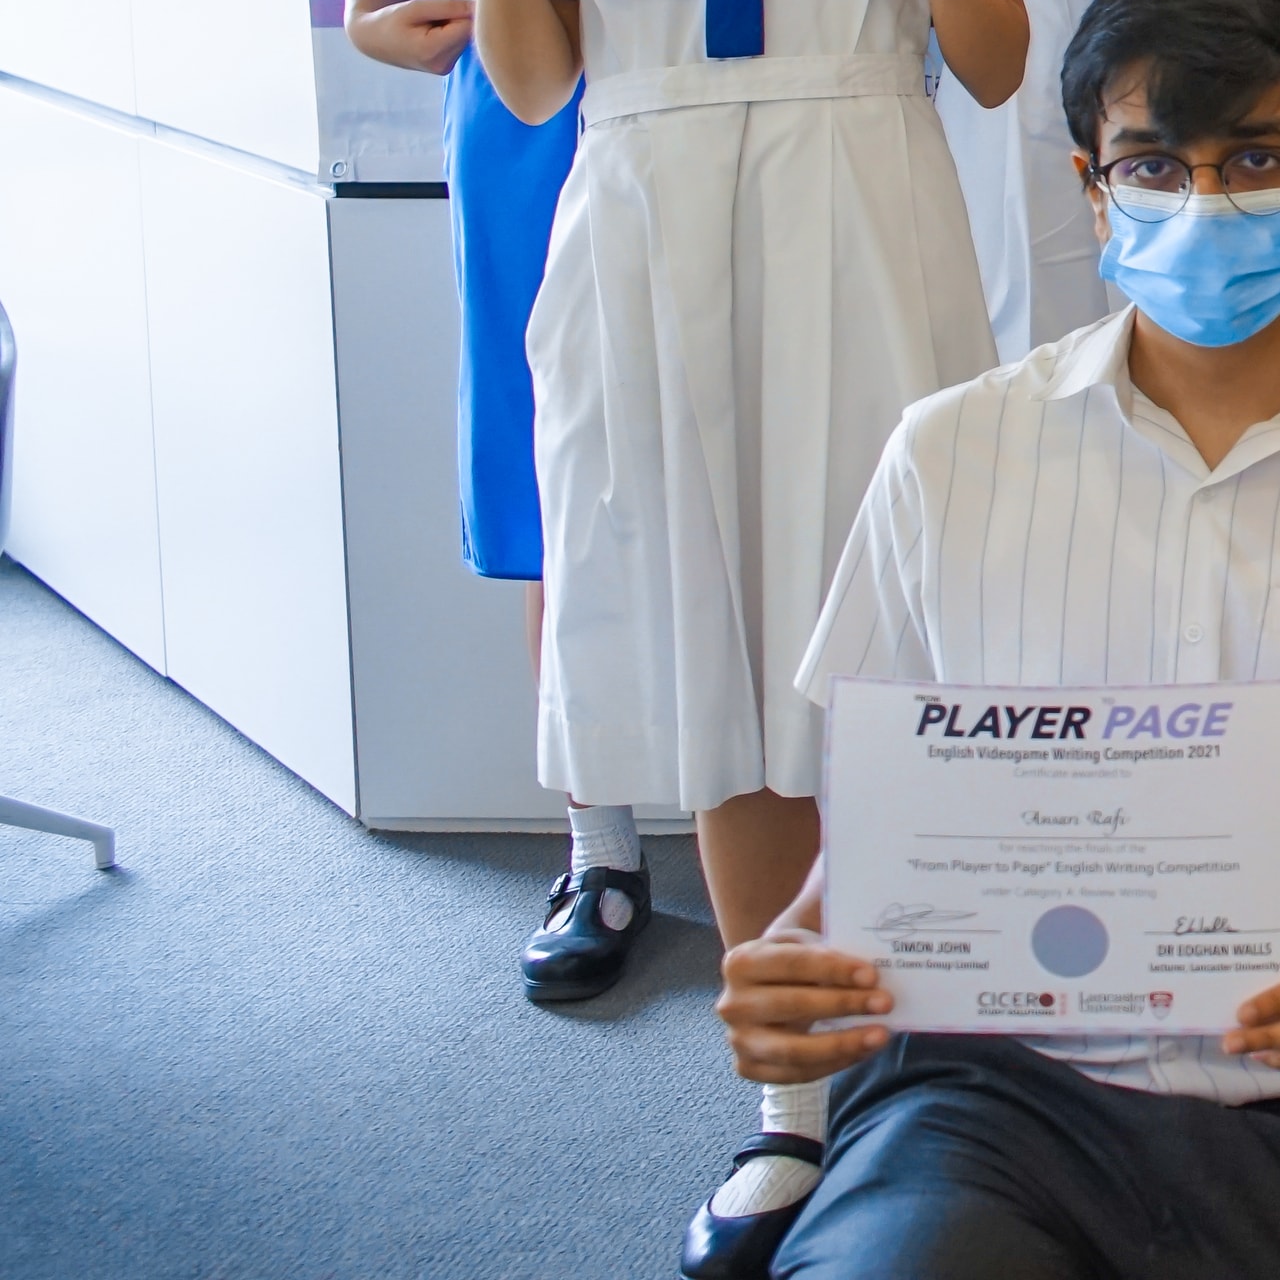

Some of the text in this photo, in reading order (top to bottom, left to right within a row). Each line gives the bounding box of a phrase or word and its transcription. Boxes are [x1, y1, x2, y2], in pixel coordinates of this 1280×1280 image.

[916, 702, 1233, 739] PLAYER PAGE
[928, 744, 1220, 764] English Videogame Writing Competition 2021
